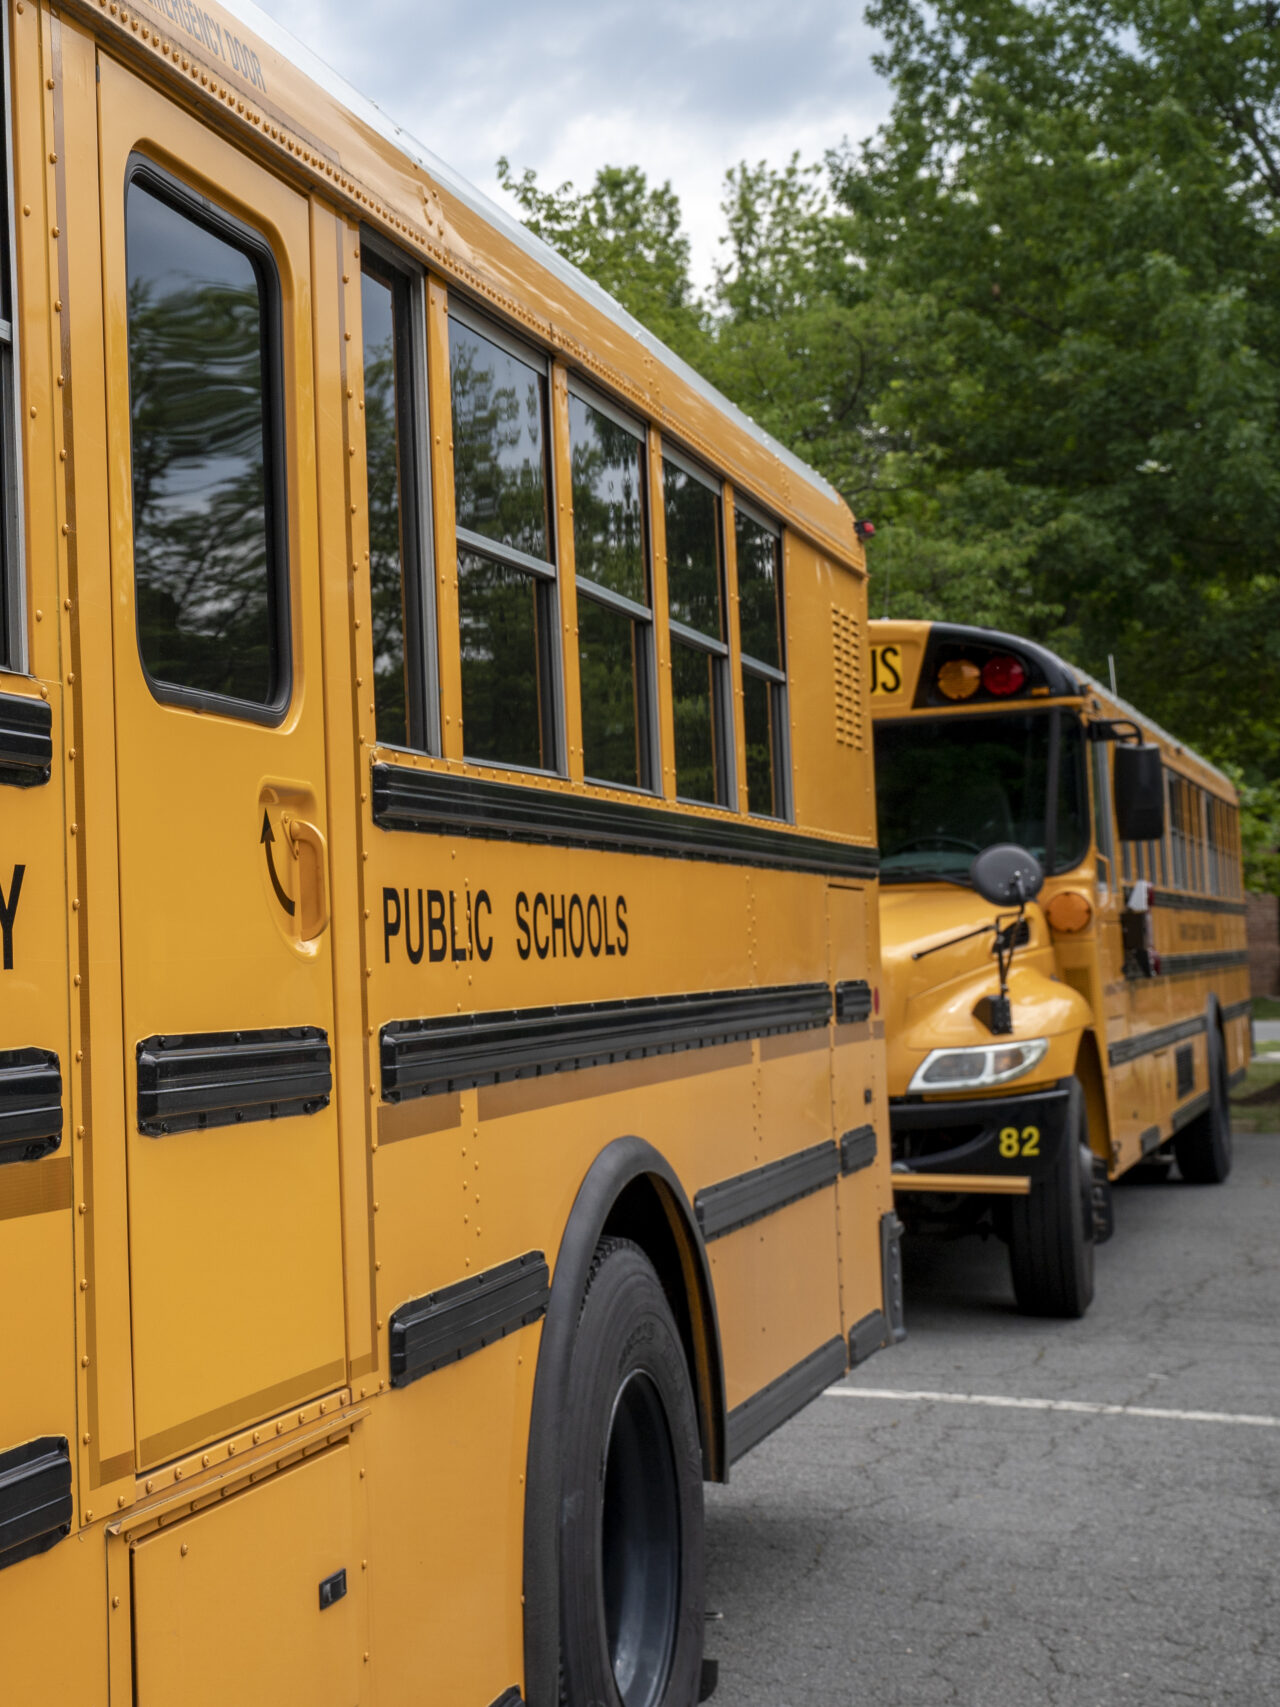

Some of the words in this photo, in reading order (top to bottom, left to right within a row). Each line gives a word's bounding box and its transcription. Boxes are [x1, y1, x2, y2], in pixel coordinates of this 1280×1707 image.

[148, 0, 227, 62] RGENCY
[223, 28, 267, 94] DOOR
[382, 886, 494, 965] PUBLIC
[515, 891, 629, 961] SCHOOLS
[999, 1125, 1040, 1158] 82
